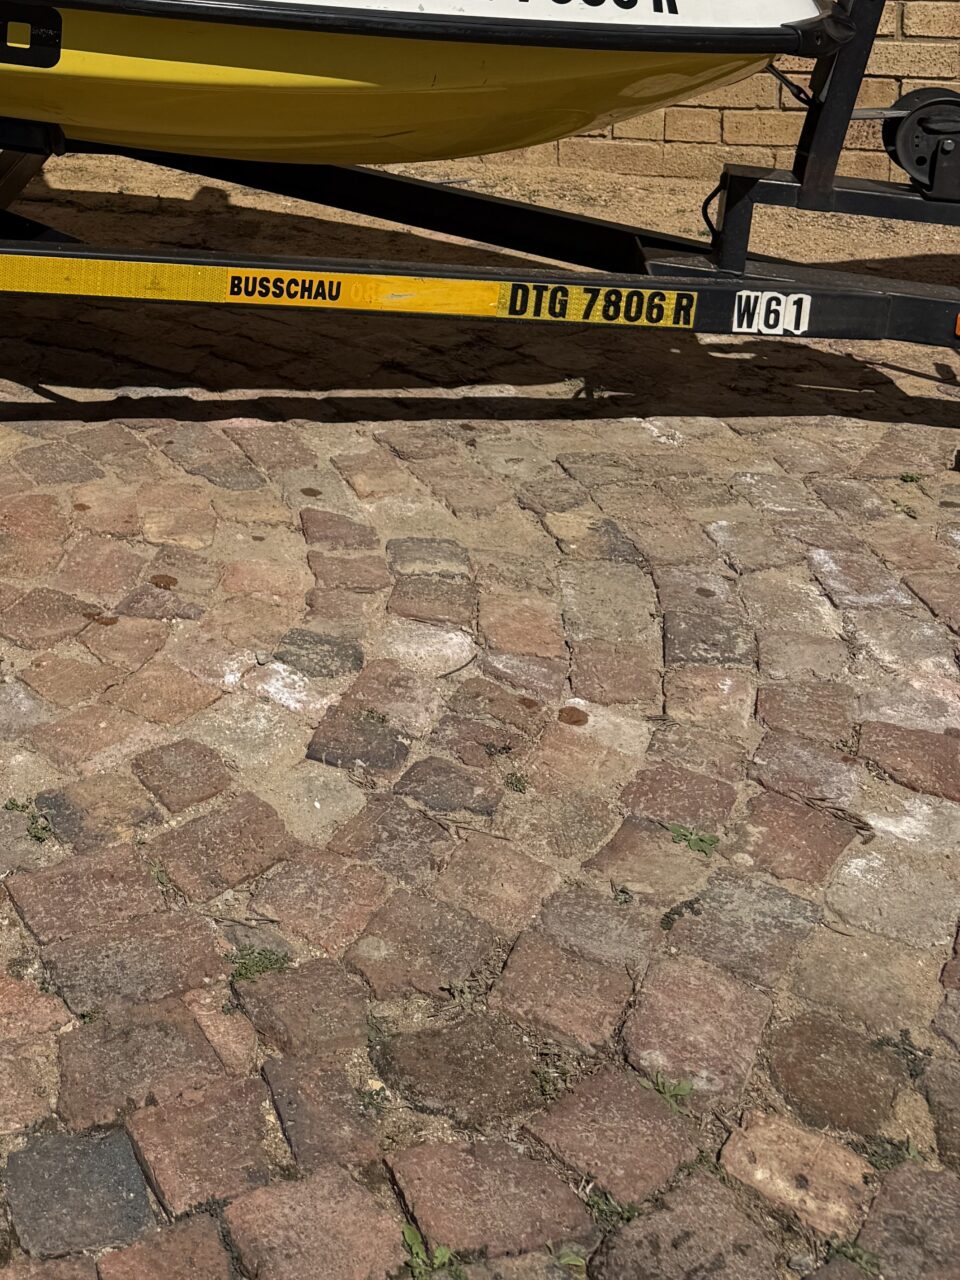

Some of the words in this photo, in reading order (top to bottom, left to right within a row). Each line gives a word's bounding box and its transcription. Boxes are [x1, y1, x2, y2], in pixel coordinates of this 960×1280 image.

[229, 275, 342, 301] BUSSCHAU
[508, 283, 569, 320] DTG
[581, 287, 666, 325] 7806
[672, 292, 695, 327] R
[737, 294, 804, 332] W61
